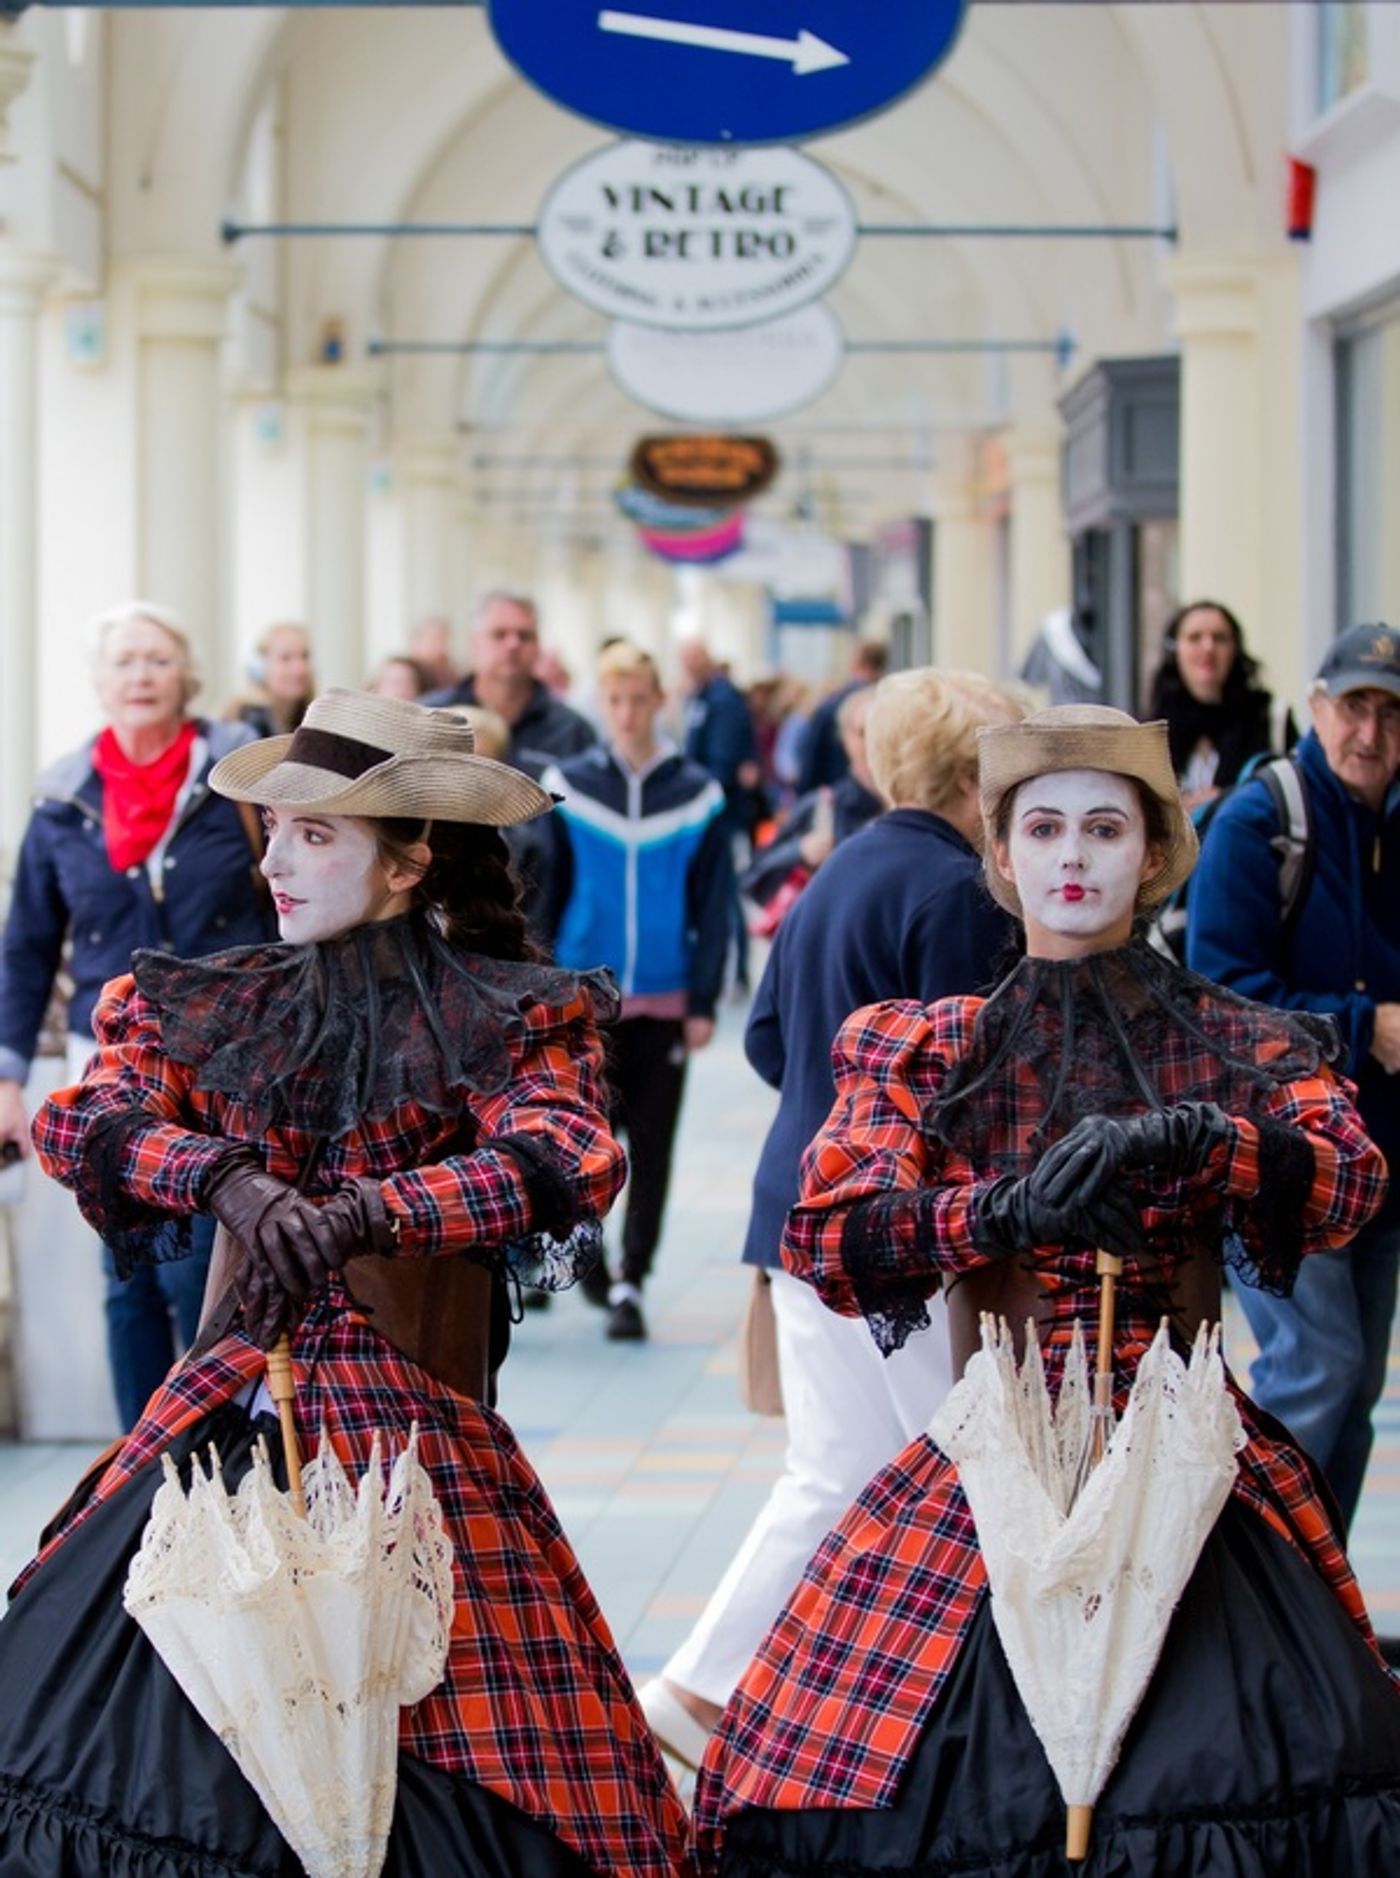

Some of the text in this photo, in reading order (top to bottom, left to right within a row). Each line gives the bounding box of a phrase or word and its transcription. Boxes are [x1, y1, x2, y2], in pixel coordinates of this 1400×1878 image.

[601, 184, 793, 214] VINTAGE
[602, 229, 796, 258] & RETRO
